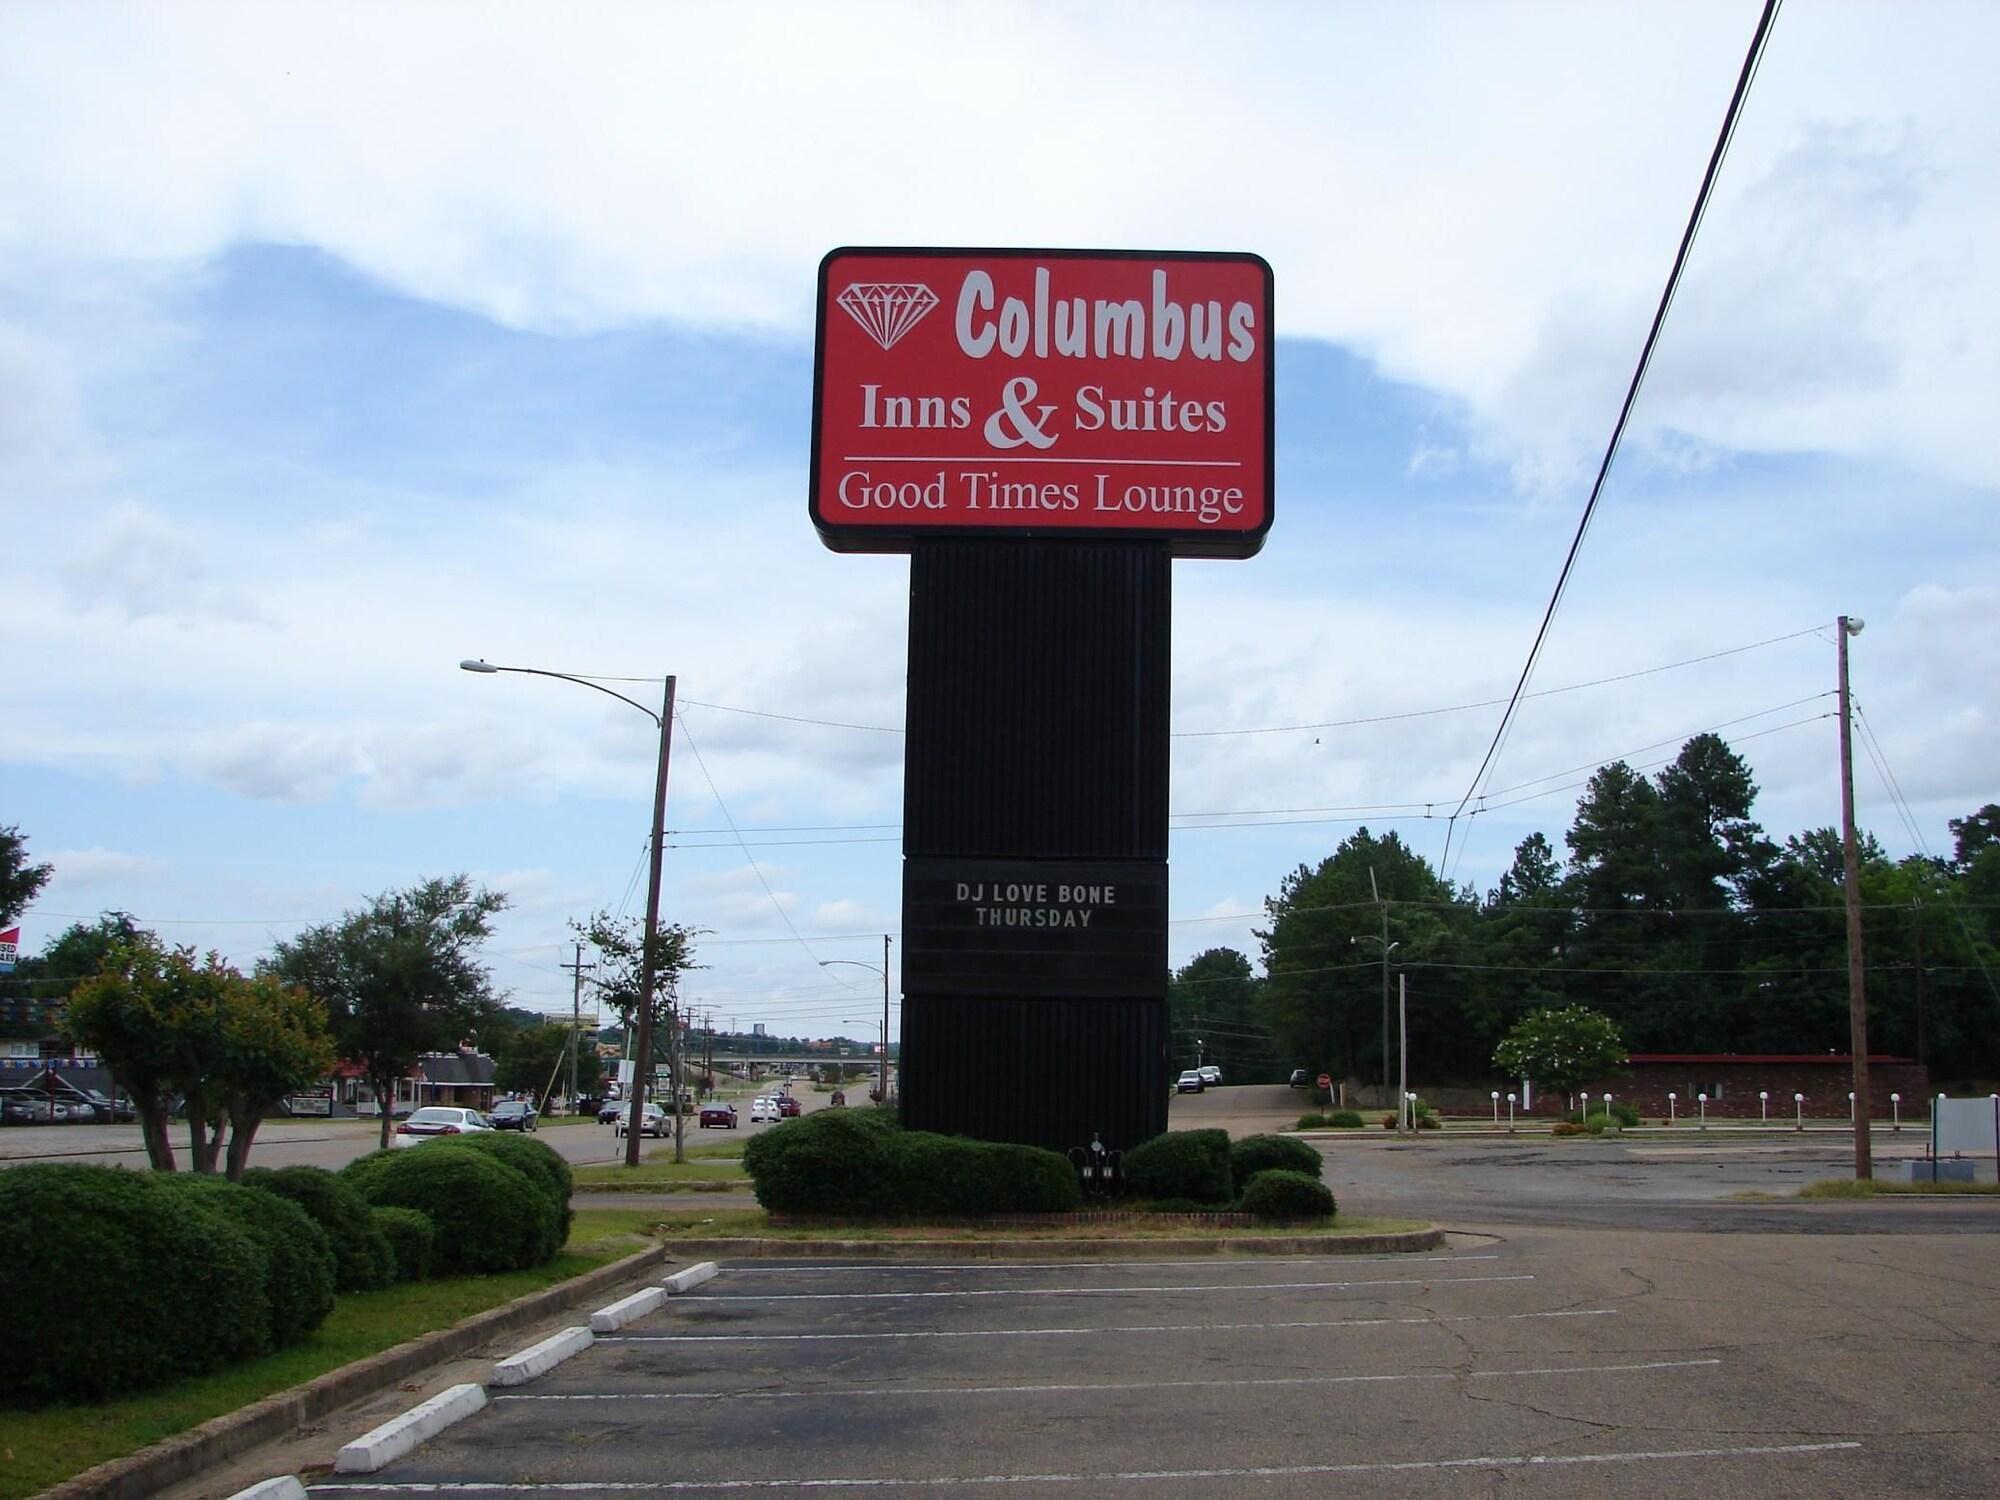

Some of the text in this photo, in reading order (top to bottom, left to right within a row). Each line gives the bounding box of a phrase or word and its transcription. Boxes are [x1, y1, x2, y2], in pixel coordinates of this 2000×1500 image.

[955, 267, 1255, 362] Columbus
[859, 376, 1227, 449] Inns & Suites
[838, 471, 1244, 524] Good Times Lounge
[956, 883, 1115, 904] DJ LOVE BONE
[975, 907, 1092, 927] THURSDAY
[0, 944, 16, 953] SED
